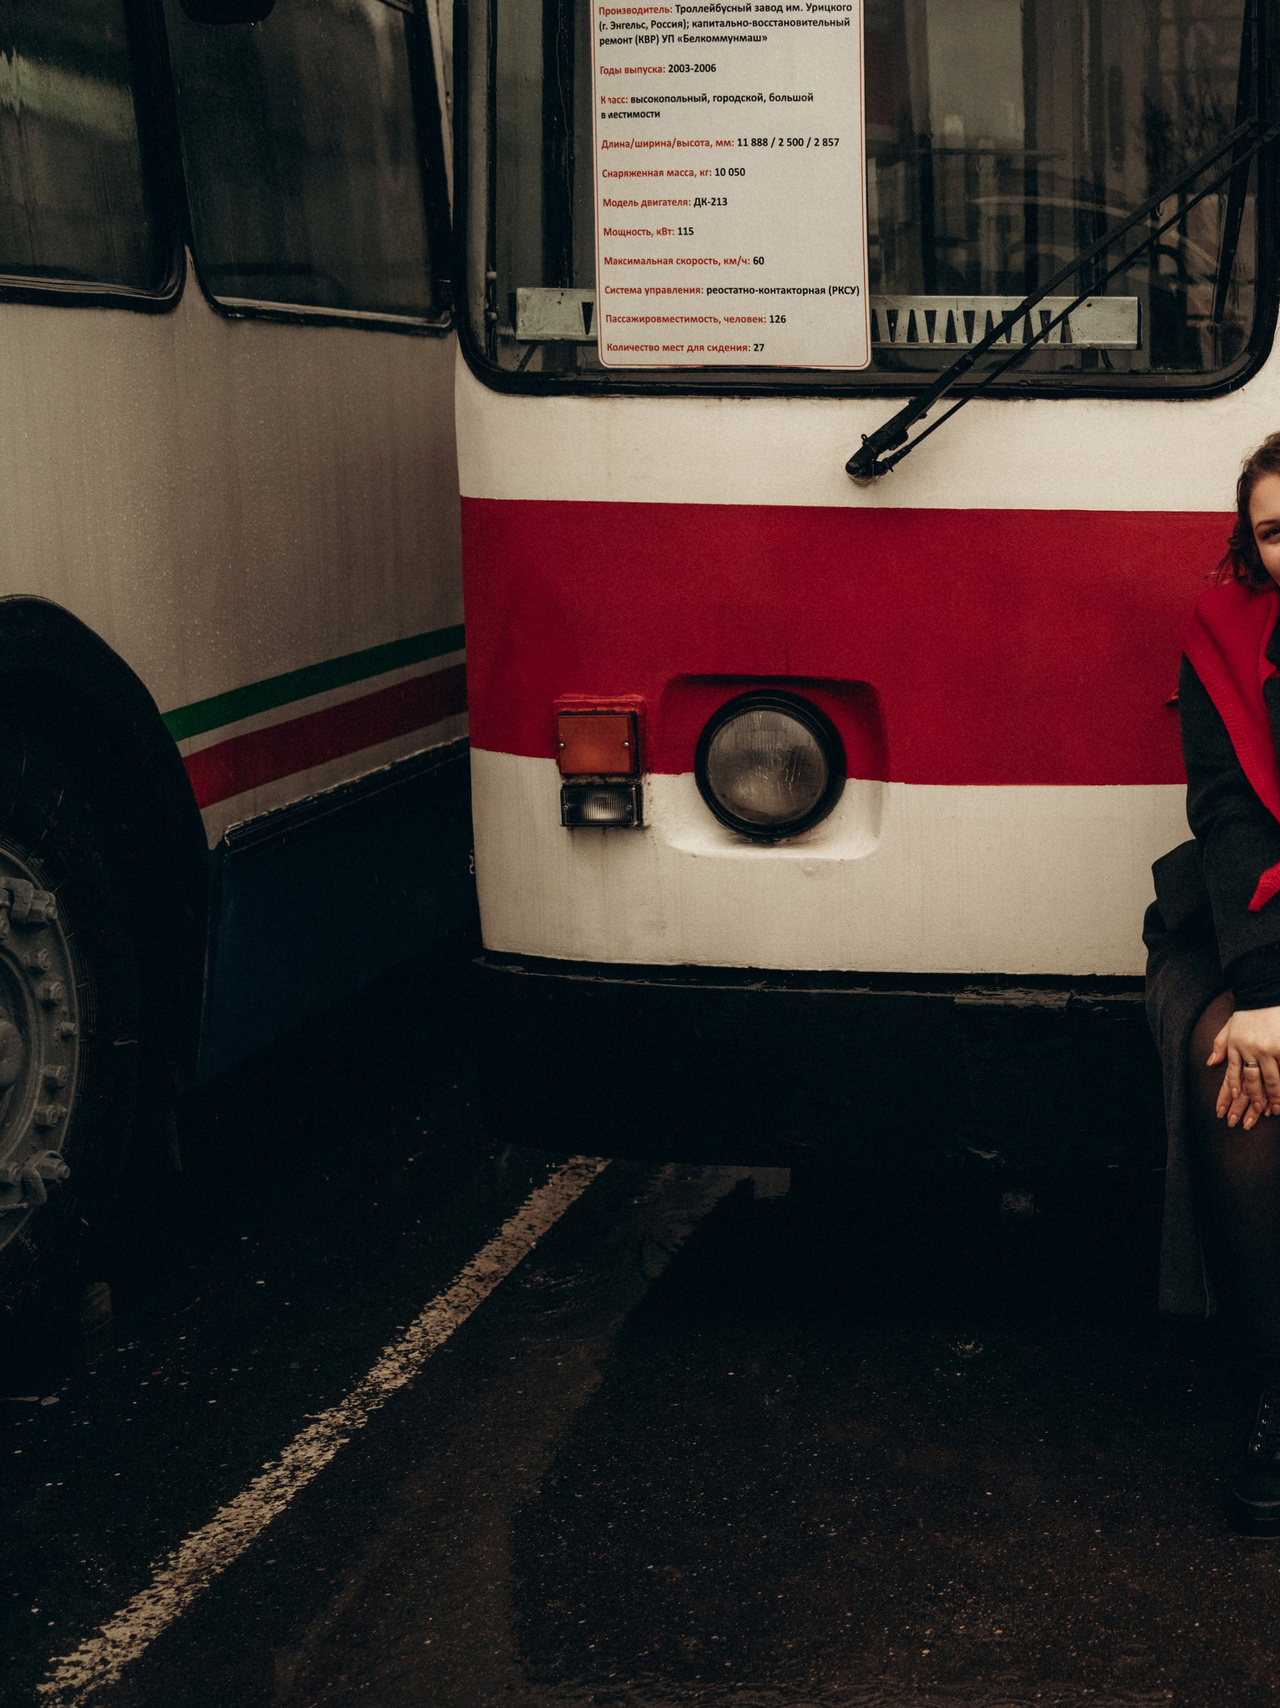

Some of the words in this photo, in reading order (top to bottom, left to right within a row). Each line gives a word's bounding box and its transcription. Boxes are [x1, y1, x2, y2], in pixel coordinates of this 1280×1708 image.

[599, 7, 672, 17] Производитель:
[675, 3, 751, 15] Троллейбусный
[754, 5, 783, 13] завод
[806, 3, 852, 13] Урицкого
[599, 21, 608, 32] (г.
[610, 21, 648, 30] Энгельс,
[651, 19, 689, 30] Россия);
[692, 17, 850, 28] капитально-восстановительный
[600, 38, 633, 47] ремонт
[635, 34, 659, 46] (КВР)
[662, 35, 674, 43] УП
[677, 34, 767, 44] «Белкоммунмаш»
[600, 66, 622, 76] Годы
[624, 66, 665, 75] выпуска:
[668, 64, 716, 73] 2003-2006
[631, 93, 710, 104] высокопольный,
[713, 93, 766, 104] городской,
[769, 93, 813, 102] большой
[601, 137, 713, 150] Длина/ширина/высота,
[738, 138, 748, 147] 11
[751, 138, 768, 147] 888
[771, 137, 776, 148] /
[778, 138, 784, 146] 2
[787, 138, 804, 147] 500
[806, 137, 811, 148] /
[814, 138, 820, 146] 2
[822, 138, 839, 147] 857
[602, 169, 664, 179] Снаряженная
[667, 170, 697, 178] масса,
[715, 168, 726, 176] 10
[728, 168, 745, 176] 050
[603, 198, 639, 208] Модель
[641, 200, 691, 208] двигателя:
[693, 197, 727, 208] ДК-213
[604, 228, 654, 237] Мощность,
[656, 227, 674, 235] кВт:
[678, 227, 694, 235] 115
[604, 257, 673, 265] Максимальная
[676, 258, 721, 267] скорость,
[724, 255, 750, 266] км/ч:
[753, 256, 764, 265] 60
[605, 286, 642, 294] Система
[644, 287, 703, 296] управления:
[706, 287, 826, 296] реостатно-контакторная
[829, 285, 859, 296] (РКСУ)
[606, 314, 721, 325] Пассажировместимость,
[770, 315, 786, 323] 126
[607, 343, 660, 351] Количество
[687, 345, 704, 353] для
[707, 345, 750, 353] сидения:
[754, 343, 764, 351] 27
